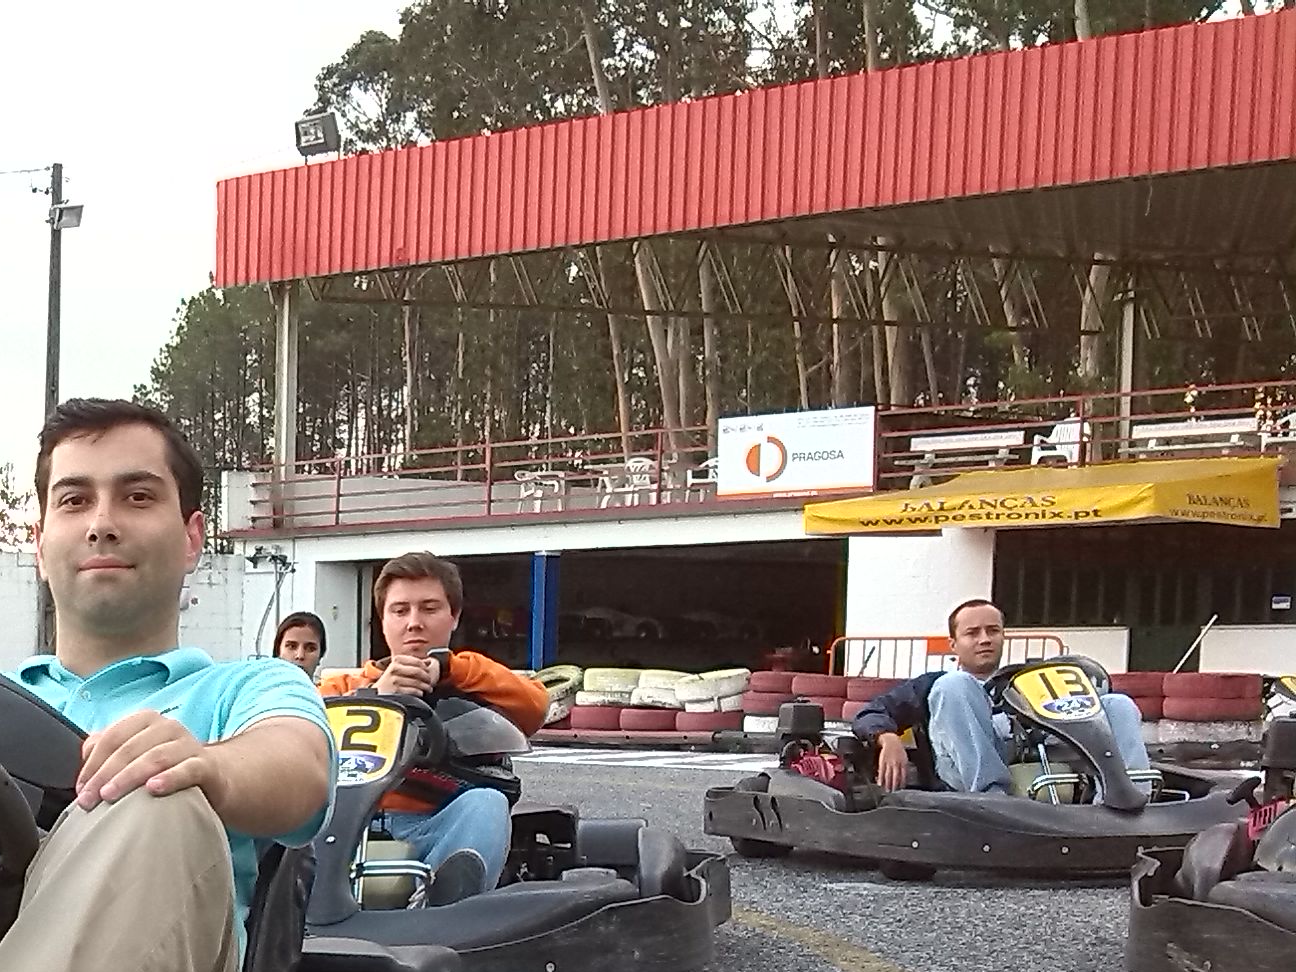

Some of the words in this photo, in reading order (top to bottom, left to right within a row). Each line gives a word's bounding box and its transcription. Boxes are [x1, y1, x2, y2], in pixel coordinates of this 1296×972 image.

[792, 449, 845, 463] PRAGOSA
[859, 507, 1103, 527] www.pestronix.pt
[1039, 669, 1091, 700] 13
[341, 709, 381, 752] 2
